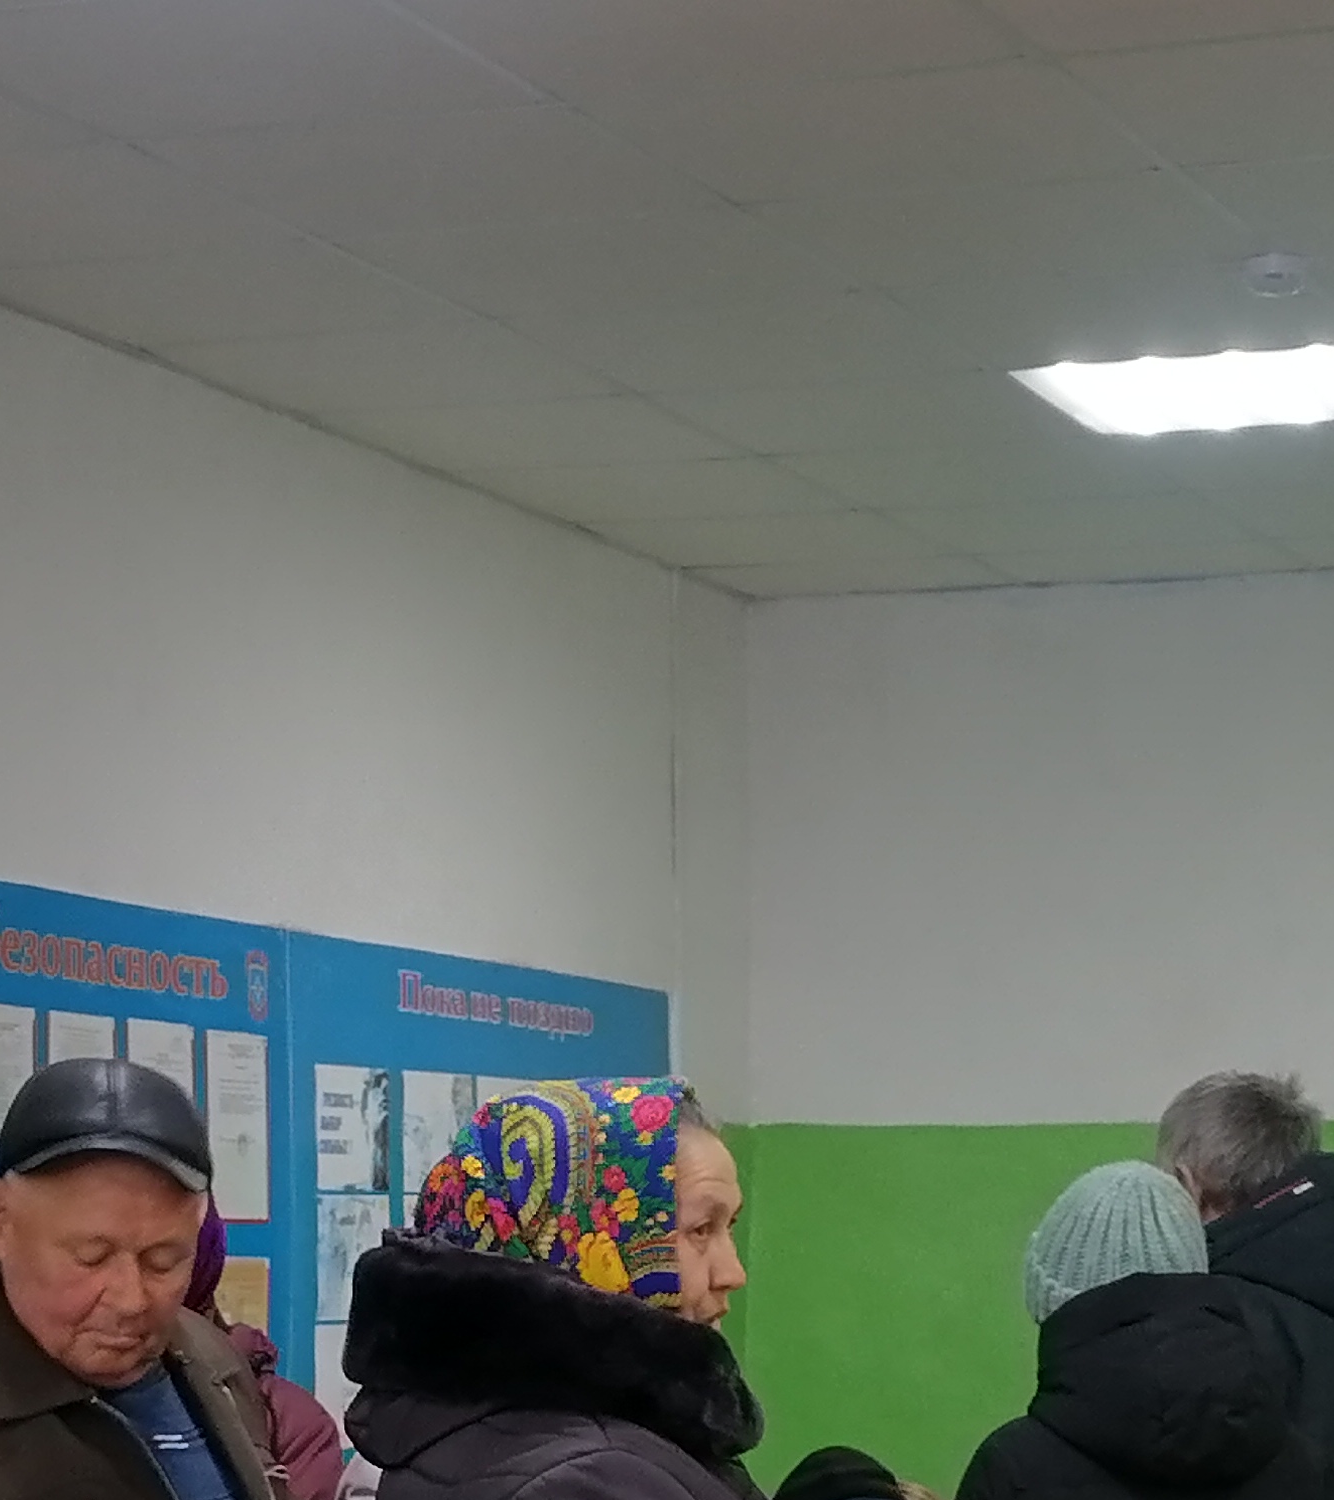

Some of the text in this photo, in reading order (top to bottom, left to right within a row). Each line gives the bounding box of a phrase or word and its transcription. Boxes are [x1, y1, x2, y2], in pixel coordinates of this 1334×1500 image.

[398, 969, 594, 1041] Пока не поздно
